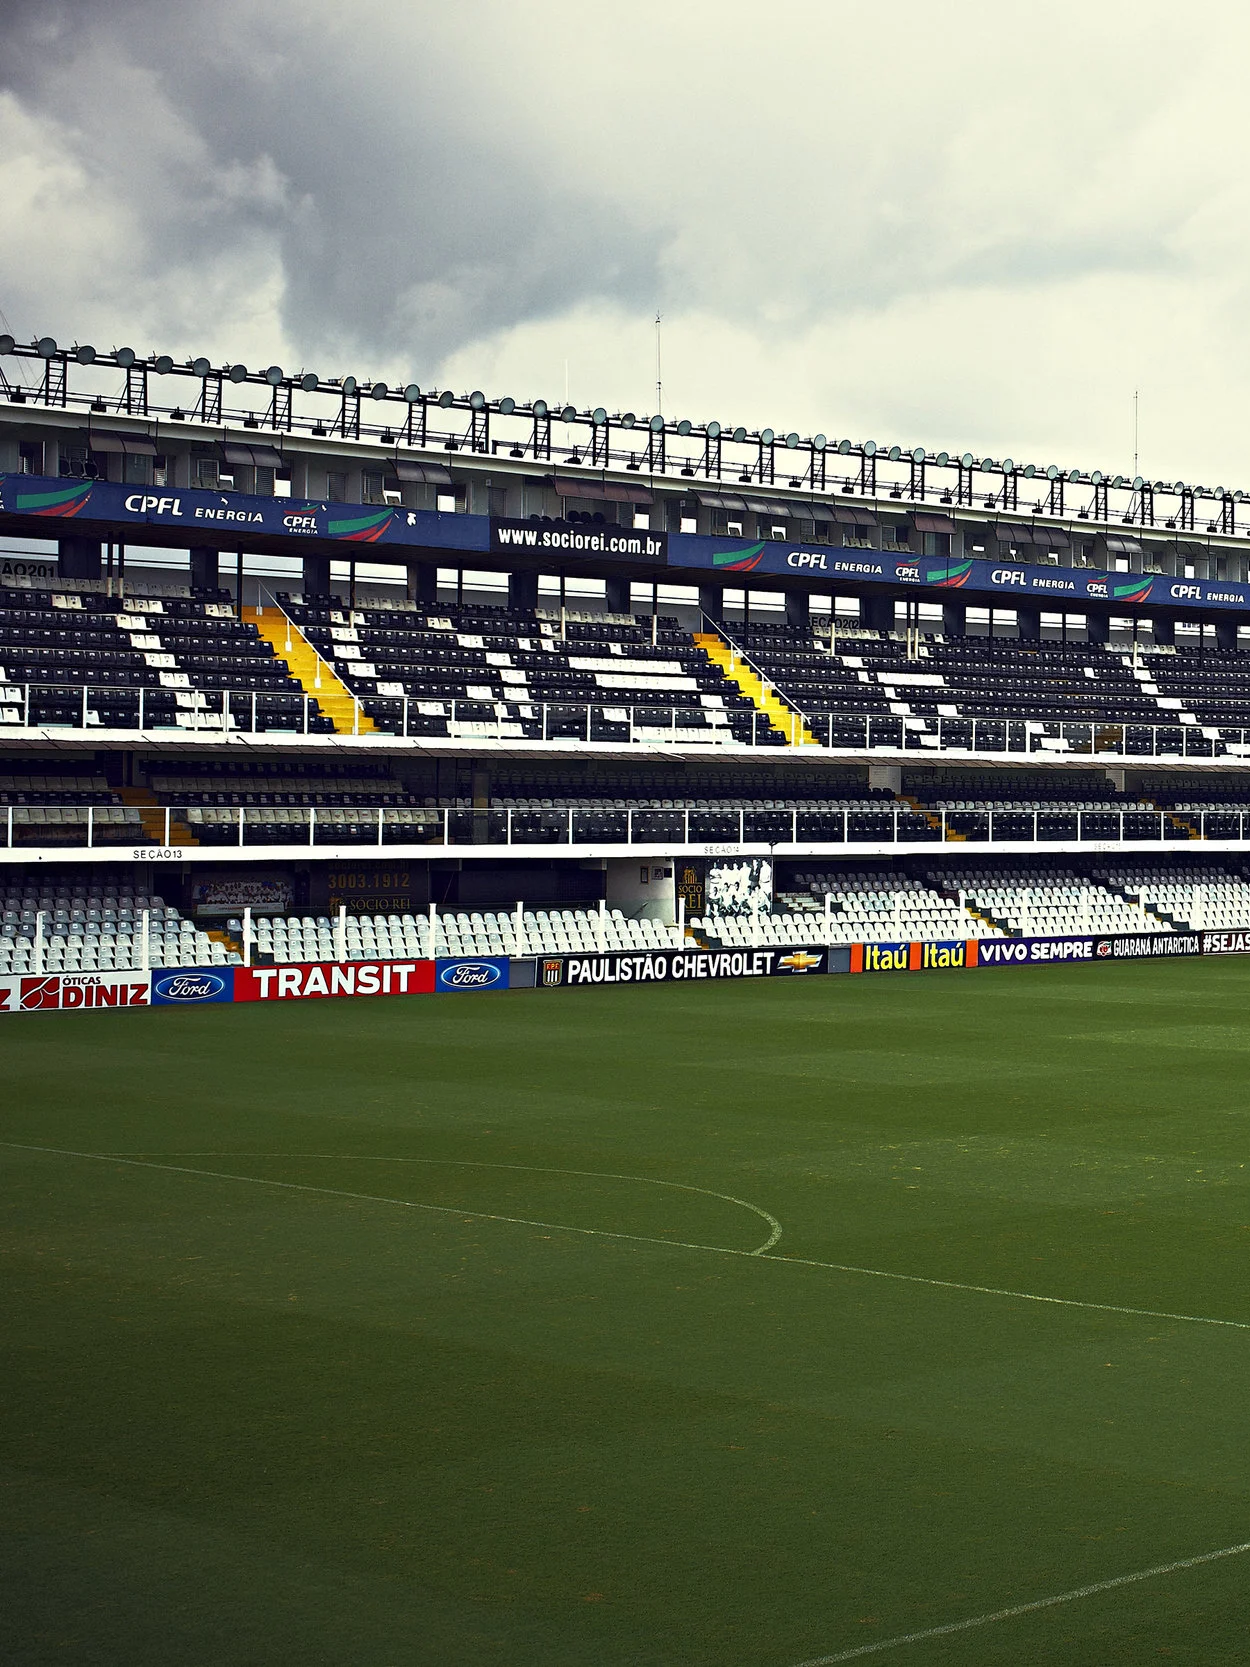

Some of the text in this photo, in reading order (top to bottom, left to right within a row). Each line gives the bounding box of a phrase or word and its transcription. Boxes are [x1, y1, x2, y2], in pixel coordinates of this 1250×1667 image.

[124, 494, 264, 523] CPFL ENERGIA
[283, 516, 316, 528] CPFL
[498, 528, 662, 556] www.sociorei.com.br
[786, 551, 883, 574] CPFL ENERGIA
[895, 566, 920, 578] CPFL
[990, 569, 1075, 590] CPFL ENERGIA
[1086, 583, 1108, 594] CPFL
[1170, 584, 1244, 603] CPFL ENERGIA
[328, 872, 410, 889] 3003.1912
[678, 884, 702, 893] SÓCIO
[350, 896, 410, 910] SÓCIO REI
[924, 943, 964, 968] Itaú
[980, 941, 1092, 962] VIVO SEMPRE
[1114, 935, 1199, 955] GUARANÁ ANTARCTICA
[567, 952, 774, 984] PAULISTÃO CHEVROLET
[866, 946, 907, 971] Itaú
[62, 974, 101, 986] ÓTICAS
[252, 964, 416, 998] TRANSIT
[453, 966, 490, 984] Ford
[62, 984, 149, 1008] DINIZ
[168, 976, 212, 998] Ford
